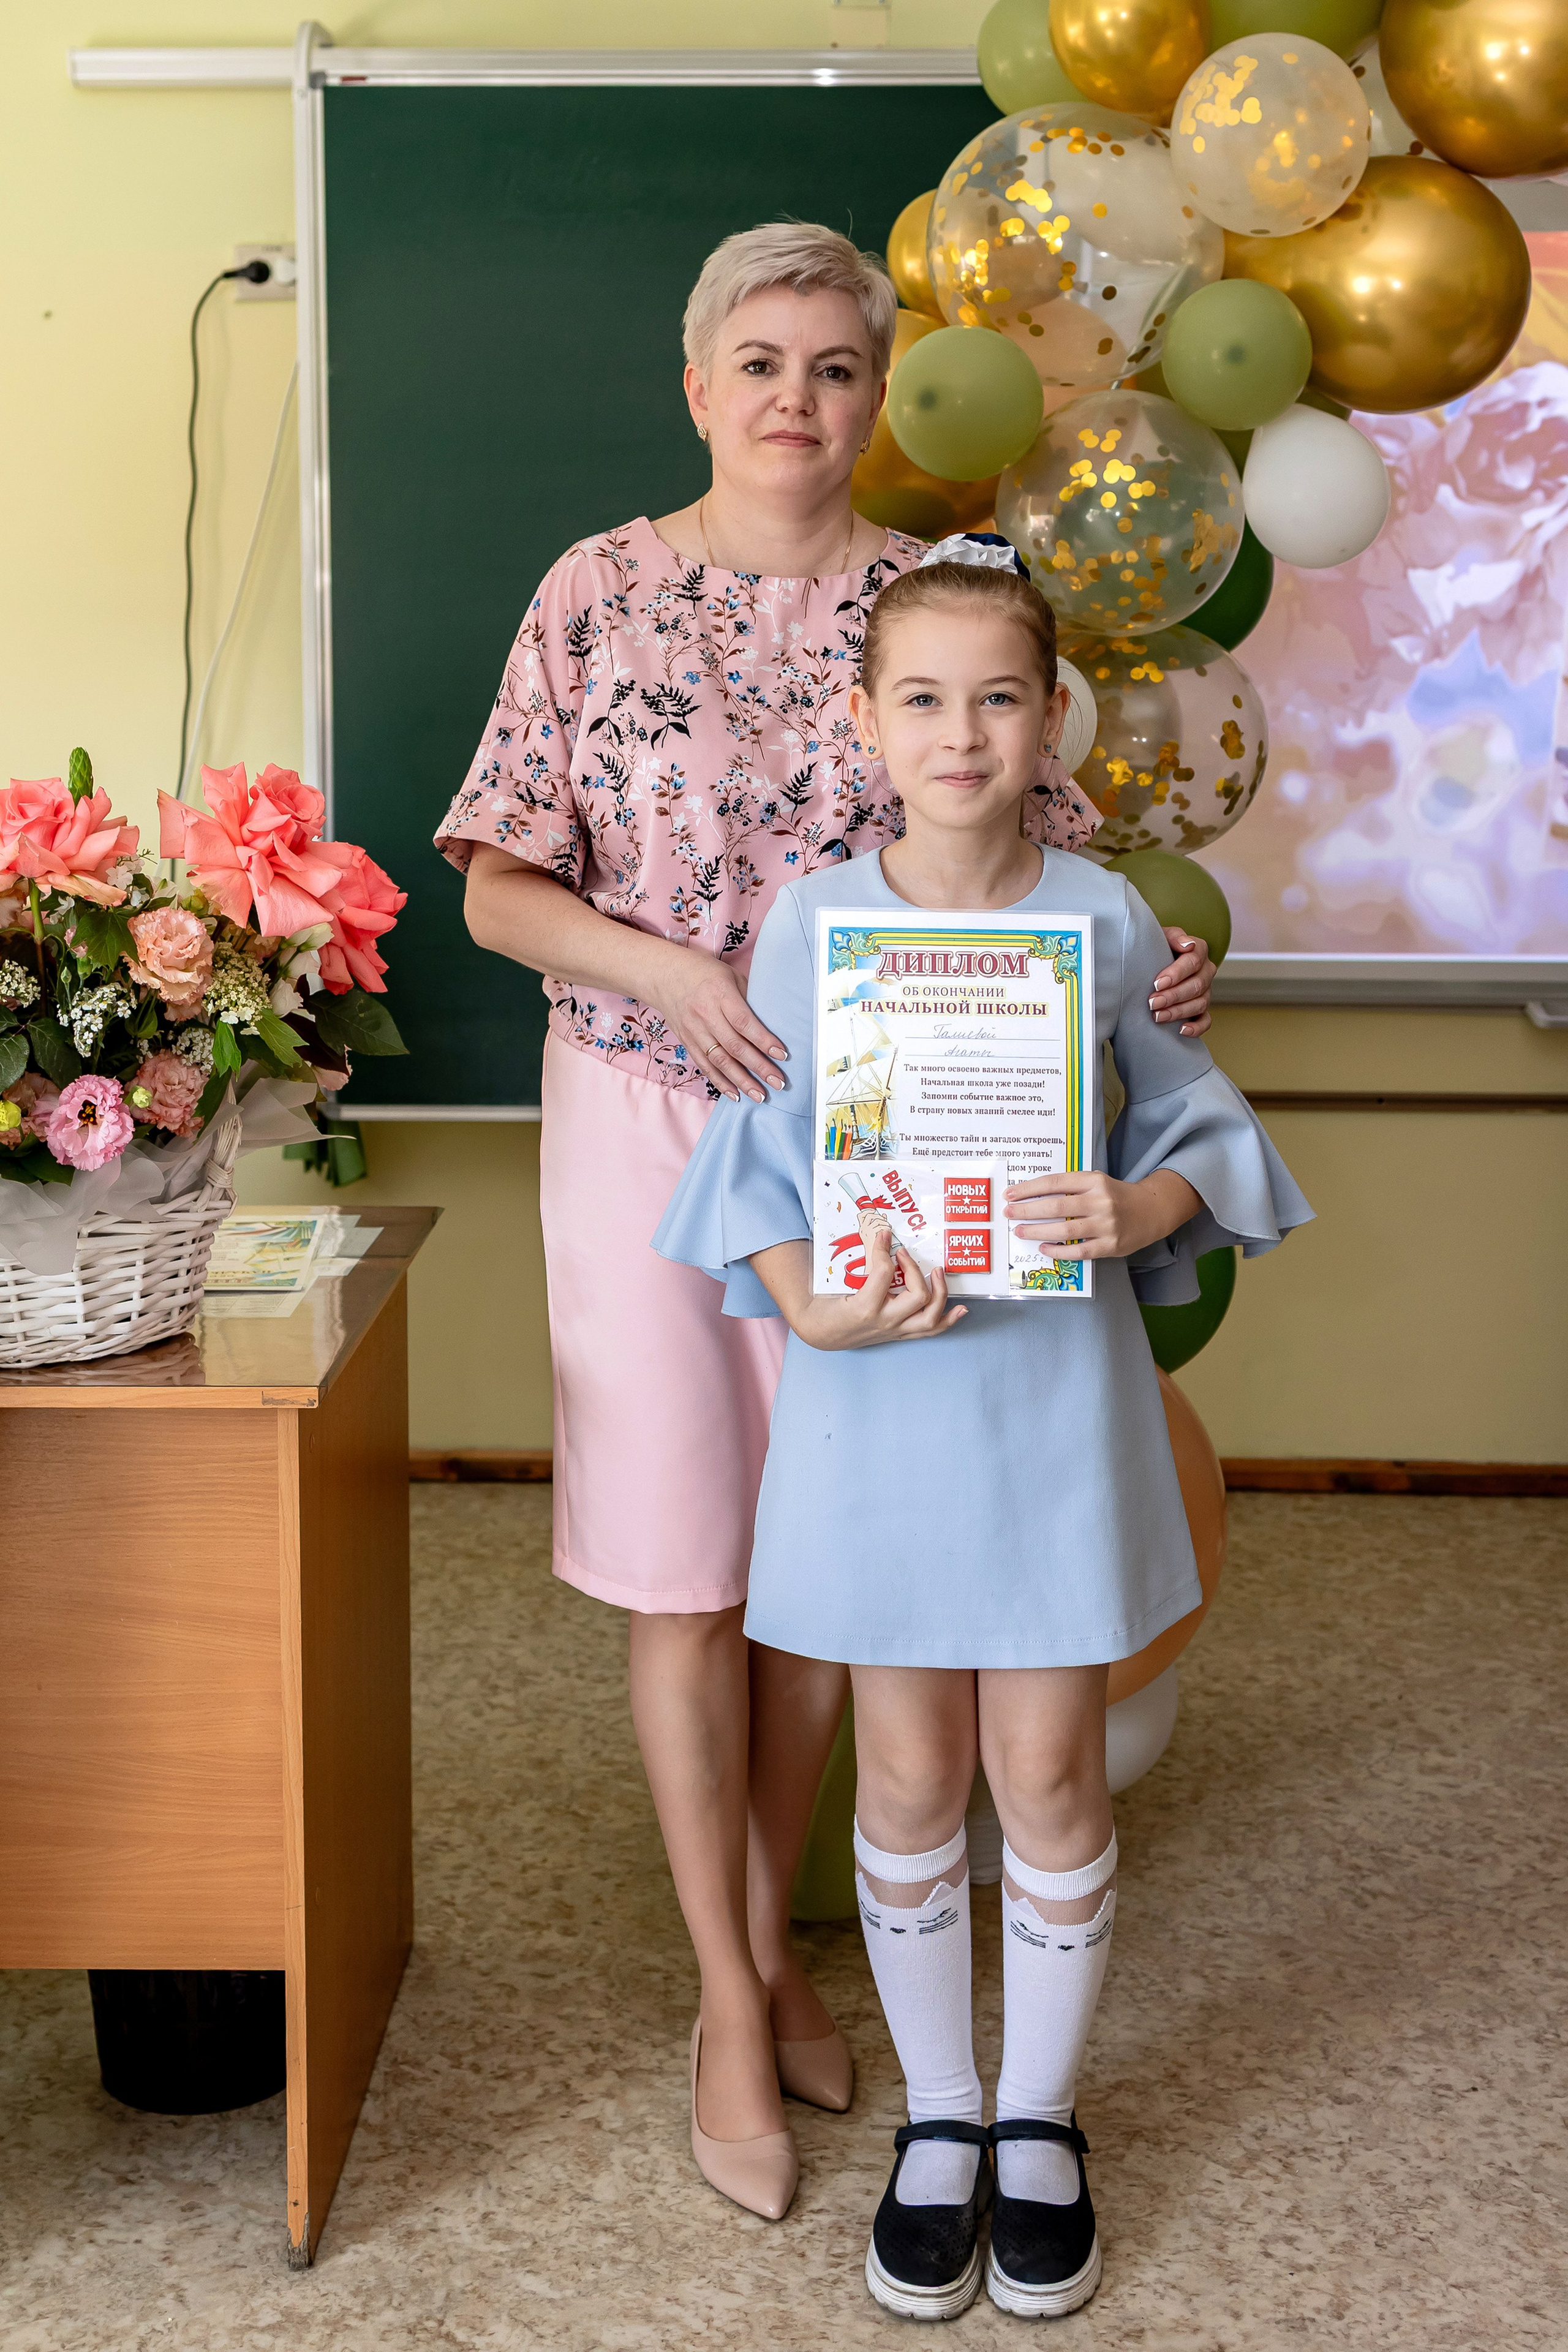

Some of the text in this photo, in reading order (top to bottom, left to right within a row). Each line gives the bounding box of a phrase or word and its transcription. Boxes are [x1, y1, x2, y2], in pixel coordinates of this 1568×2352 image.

[877, 951, 1029, 979] ДИПЛОМ
[903, 987, 1005, 997] ОБ ОКОНЧАНИИ
[861, 1000, 1047, 1016] НАЧАЛЬНОЙ ШКОЛЫ
[921, 1078, 965, 1087] Начальная
[960, 1093, 993, 1101] событие
[1023, 1137, 1065, 1145] откроешь,
[913, 1147, 929, 1156] Ещё
[1023, 1150, 1052, 1159] узнать!
[948, 1185, 986, 1196] НОВЫХ
[946, 1204, 988, 1214] ОТКРЫТИЙ
[949, 1235, 984, 1246] ЯРКИХ
[948, 1256, 986, 1266] СОБЫТИЙ
